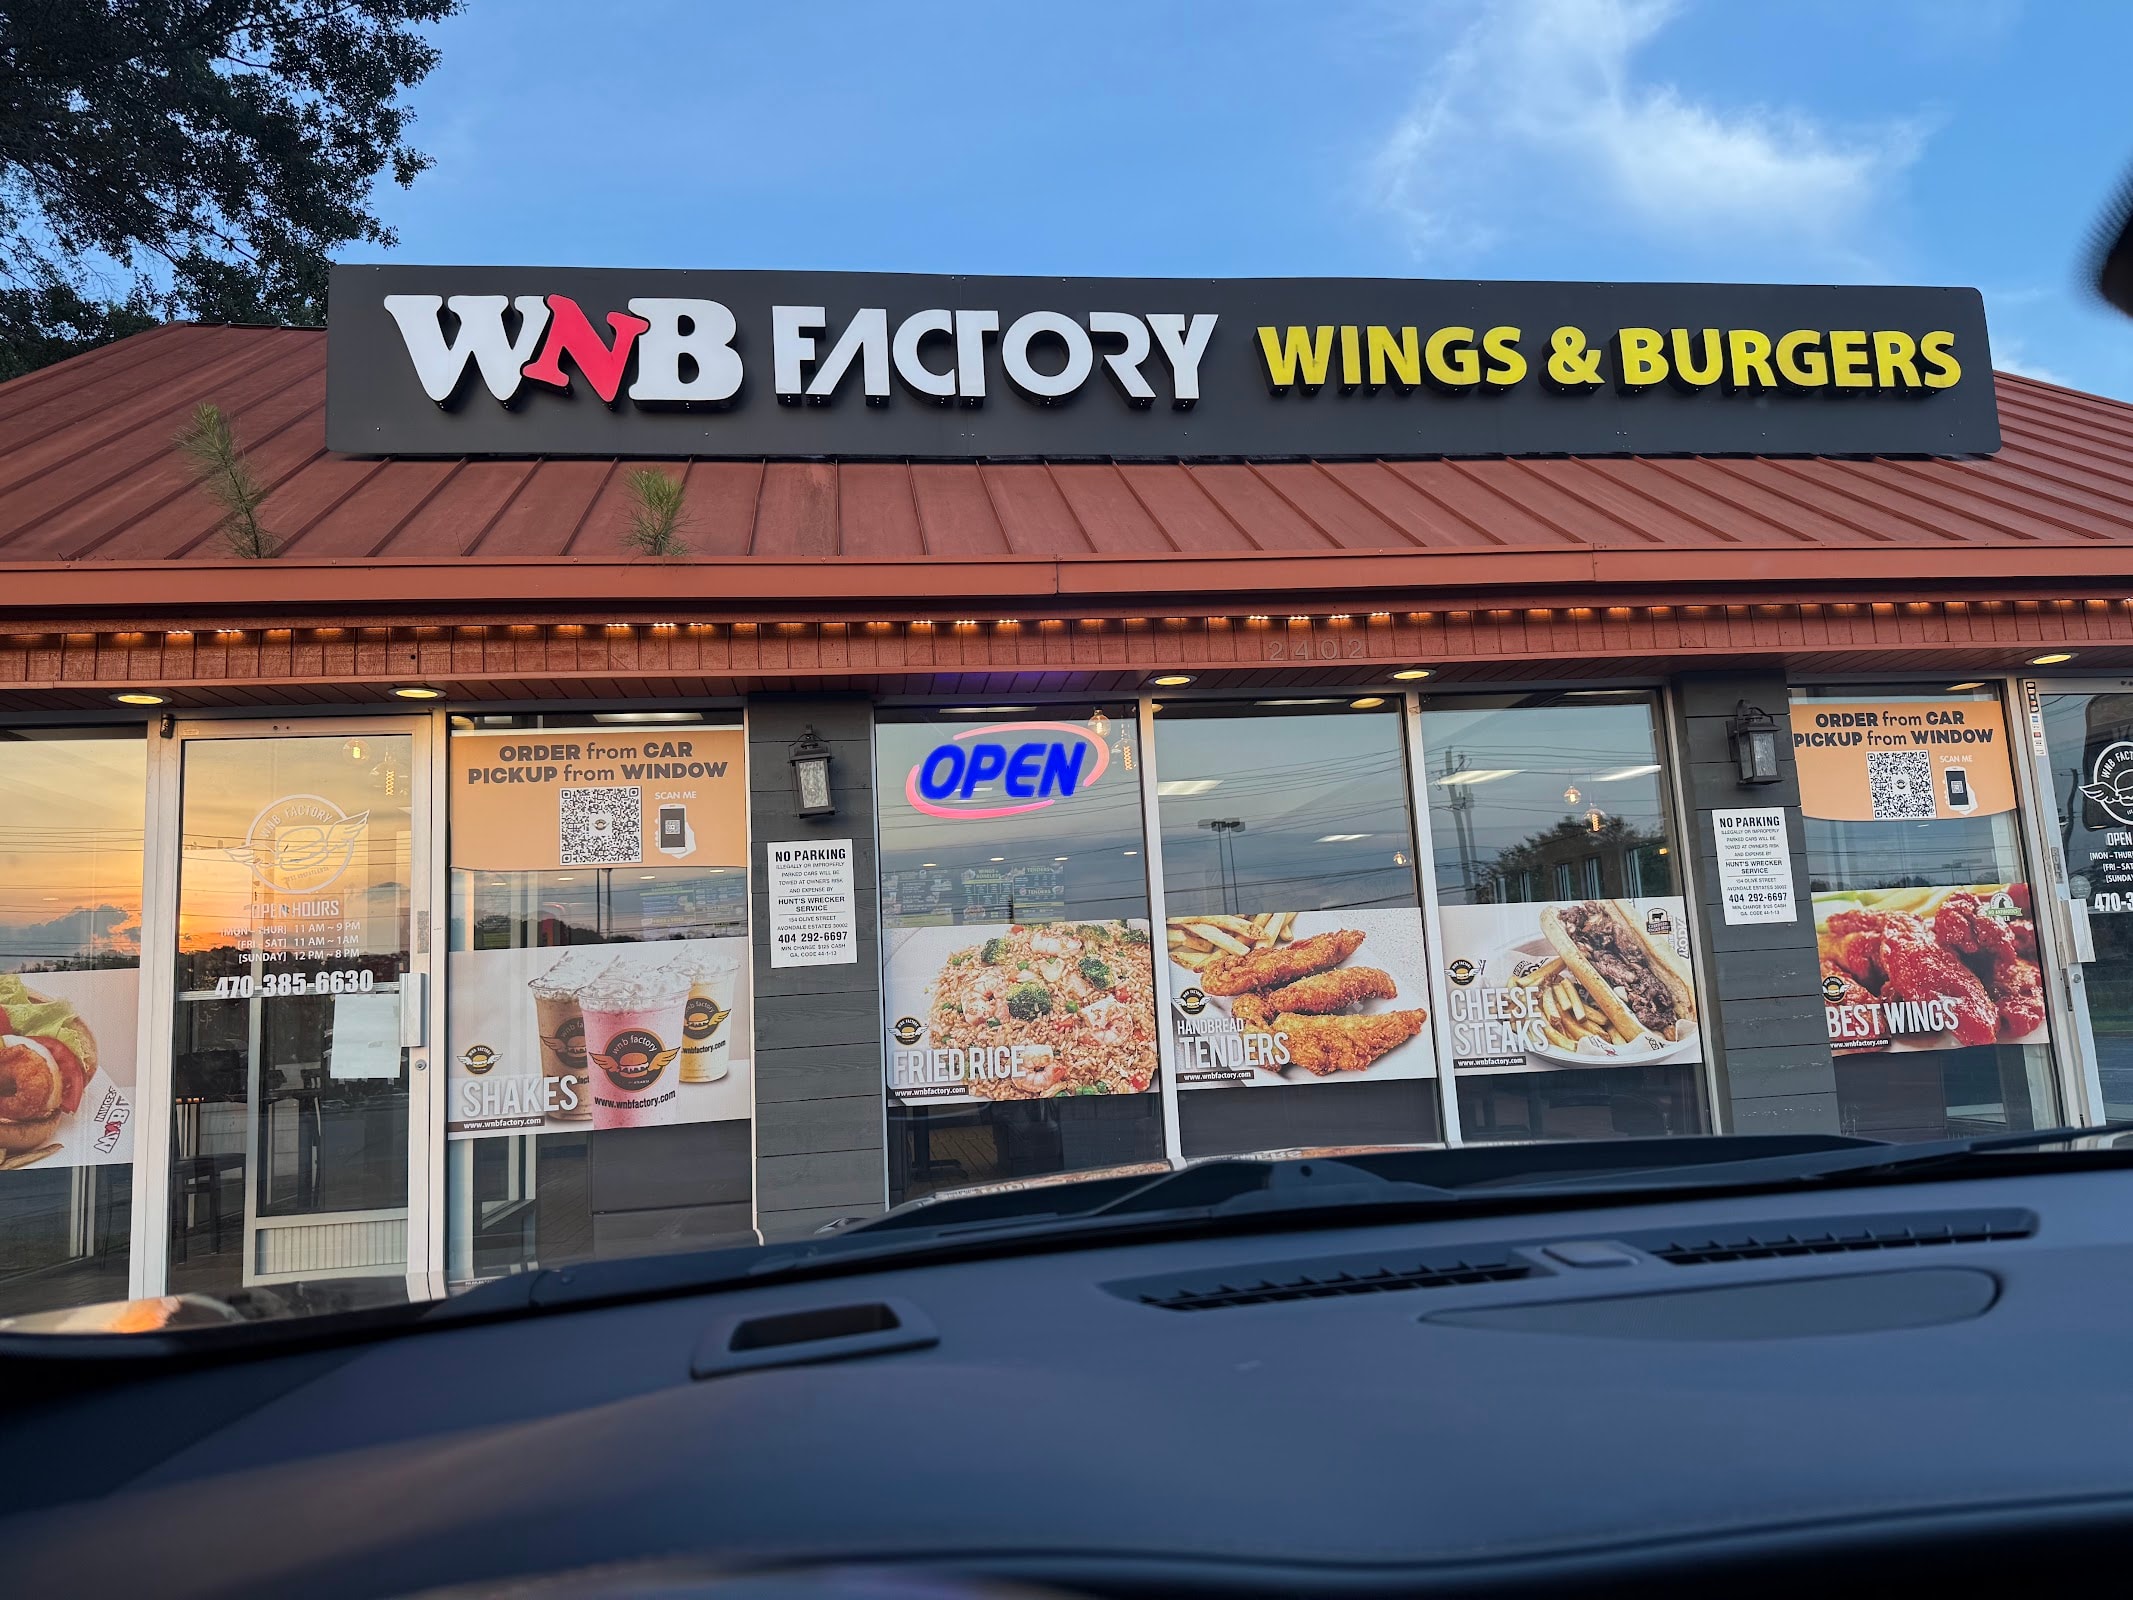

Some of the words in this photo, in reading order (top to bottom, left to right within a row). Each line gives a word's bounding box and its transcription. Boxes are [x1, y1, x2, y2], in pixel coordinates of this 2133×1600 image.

[384, 294, 744, 403] WNB
[772, 305, 1218, 399] FACTORY
[1257, 325, 1527, 386] WINGS
[1548, 326, 1604, 384] &
[1618, 328, 1961, 388] BURGERS
[1269, 639, 1364, 661] 2402
[1815, 712, 1878, 728] ORDER
[1882, 711, 1922, 726] from
[1926, 710, 1965, 725] CAR
[1794, 731, 1863, 748] PICKUP
[1867, 730, 1907, 746] from
[1910, 728, 1993, 745] WINDOW
[499, 744, 580, 762] ORDER
[586, 742, 637, 760] from
[643, 741, 693, 758] CAR
[1939, 755, 1960, 763] SCAN
[468, 767, 558, 785] PICKUP
[563, 764, 615, 782] from
[620, 762, 728, 780] WINDOW
[919, 741, 1087, 800] OPEN
[2100, 758, 2116, 779] WNB
[655, 791, 681, 800] SCAN
[683, 790, 697, 799] ME
[260, 814, 281, 838] WNB
[284, 805, 333, 823] FACTORY
[1719, 817, 1733, 828] NO
[1736, 816, 1780, 827] PARKING
[2107, 832, 2133, 846] OPEN
[775, 851, 791, 862] NO
[794, 848, 846, 861] PARKING
[2114, 851, 2133, 859] THUR
[1728, 894, 1745, 903] 404
[1747, 892, 1787, 902] 292-6697
[251, 903, 289, 919] OPEN
[292, 901, 340, 917] HOURS
[220, 928, 248, 937] [MON
[257, 925, 287, 935] THUR]
[294, 925, 305, 933] 11
[308, 923, 325, 933] AM
[336, 923, 342, 931] 9
[345, 921, 361, 931] PM
[238, 940, 255, 950] [FRI
[264, 938, 287, 948] SAT]
[294, 938, 305, 947] 11
[308, 937, 325, 946] AM
[778, 933, 796, 944] 404
[801, 931, 848, 943] 292-6697
[239, 952, 287, 964] [SUNDAY]
[294, 952, 305, 961] 12
[308, 950, 324, 960] PM
[336, 950, 342, 959] 8
[345, 949, 360, 958] PM
[214, 969, 374, 999] 470-385-6630
[1450, 986, 1542, 1022] CHEESE
[1177, 1017, 1244, 1036] HANDBREAD
[1825, 1004, 1883, 1038] BEST
[1884, 999, 1959, 1034] WINGS
[612, 1038, 629, 1054] wnb
[630, 1035, 658, 1052] factory
[1453, 1019, 1549, 1056] STEAKS
[1179, 1032, 1290, 1069] TENDERS
[892, 1048, 965, 1085] FRIED
[969, 1045, 1027, 1079] RICE
[1457, 1057, 1524, 1067] www.wnbfactory.com
[1183, 1071, 1251, 1082] www.wnbfactory.com
[462, 1074, 578, 1117] SHAKES
[594, 1090, 676, 1110] www.wnbfactory.com
[895, 1086, 966, 1097] www.wnbfactory.com
[463, 1117, 542, 1130] www.wnbfactory.com
